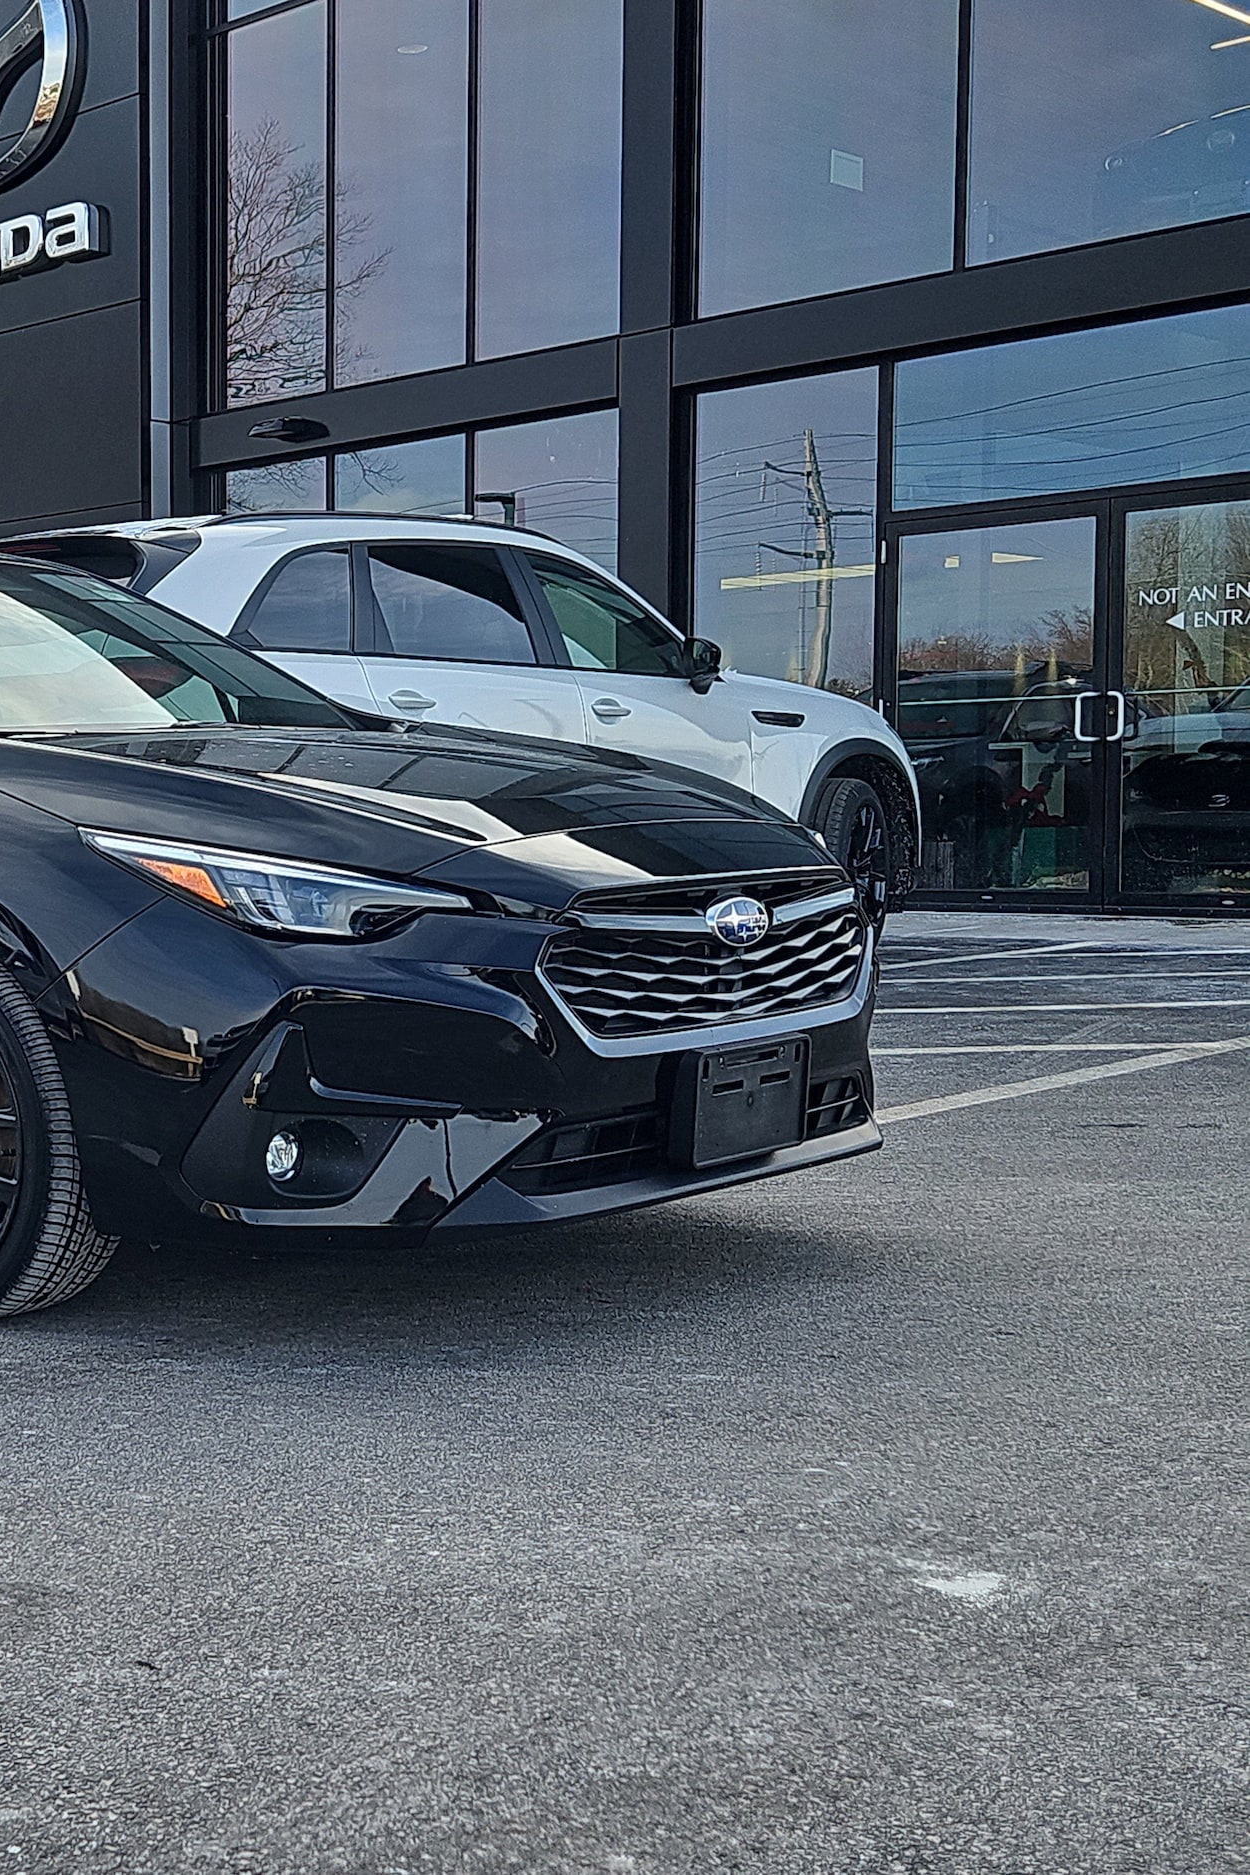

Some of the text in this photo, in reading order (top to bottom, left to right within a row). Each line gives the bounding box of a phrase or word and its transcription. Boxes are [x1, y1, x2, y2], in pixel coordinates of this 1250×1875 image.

[1137, 582, 1250, 606] NOT AN EN
